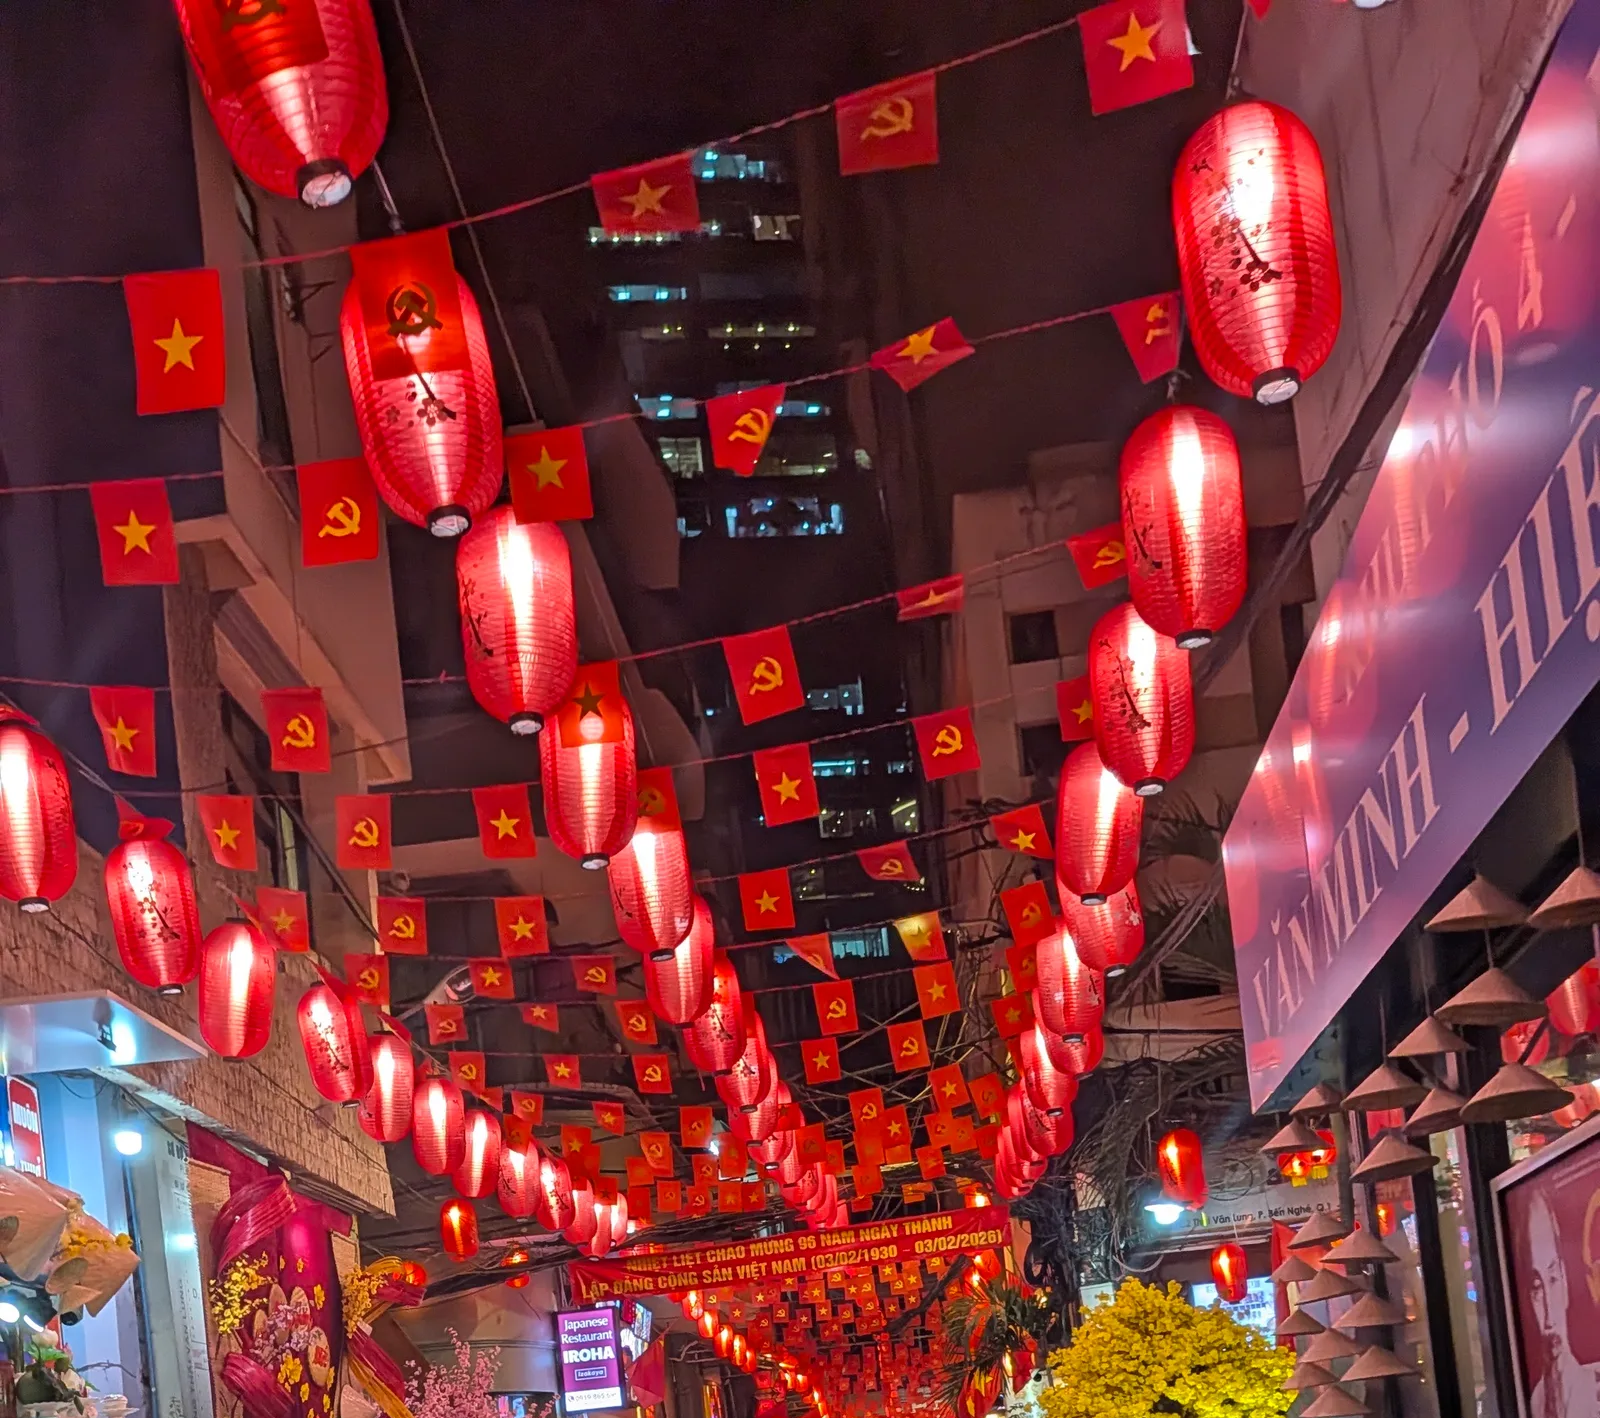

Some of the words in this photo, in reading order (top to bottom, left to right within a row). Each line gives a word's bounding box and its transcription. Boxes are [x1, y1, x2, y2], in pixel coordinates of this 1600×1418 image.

[1253, 894, 1316, 1038] VĂN
[1317, 692, 1441, 970] MINH
[798, 1236, 816, 1251] 96
[859, 1221, 899, 1242] NGÀY
[902, 1215, 953, 1236] THÀNH
[657, 1270, 699, 1291] CỘNG
[702, 1264, 734, 1283] SẢN
[735, 1260, 769, 1281] VIỆT
[771, 1257, 807, 1275] NAM
[914, 1228, 1003, 1255] 03/02/2026)
[561, 1329, 613, 1344] Restaurant
[564, 1317, 609, 1332] Japanese
[562, 1345, 615, 1364] IROHA
